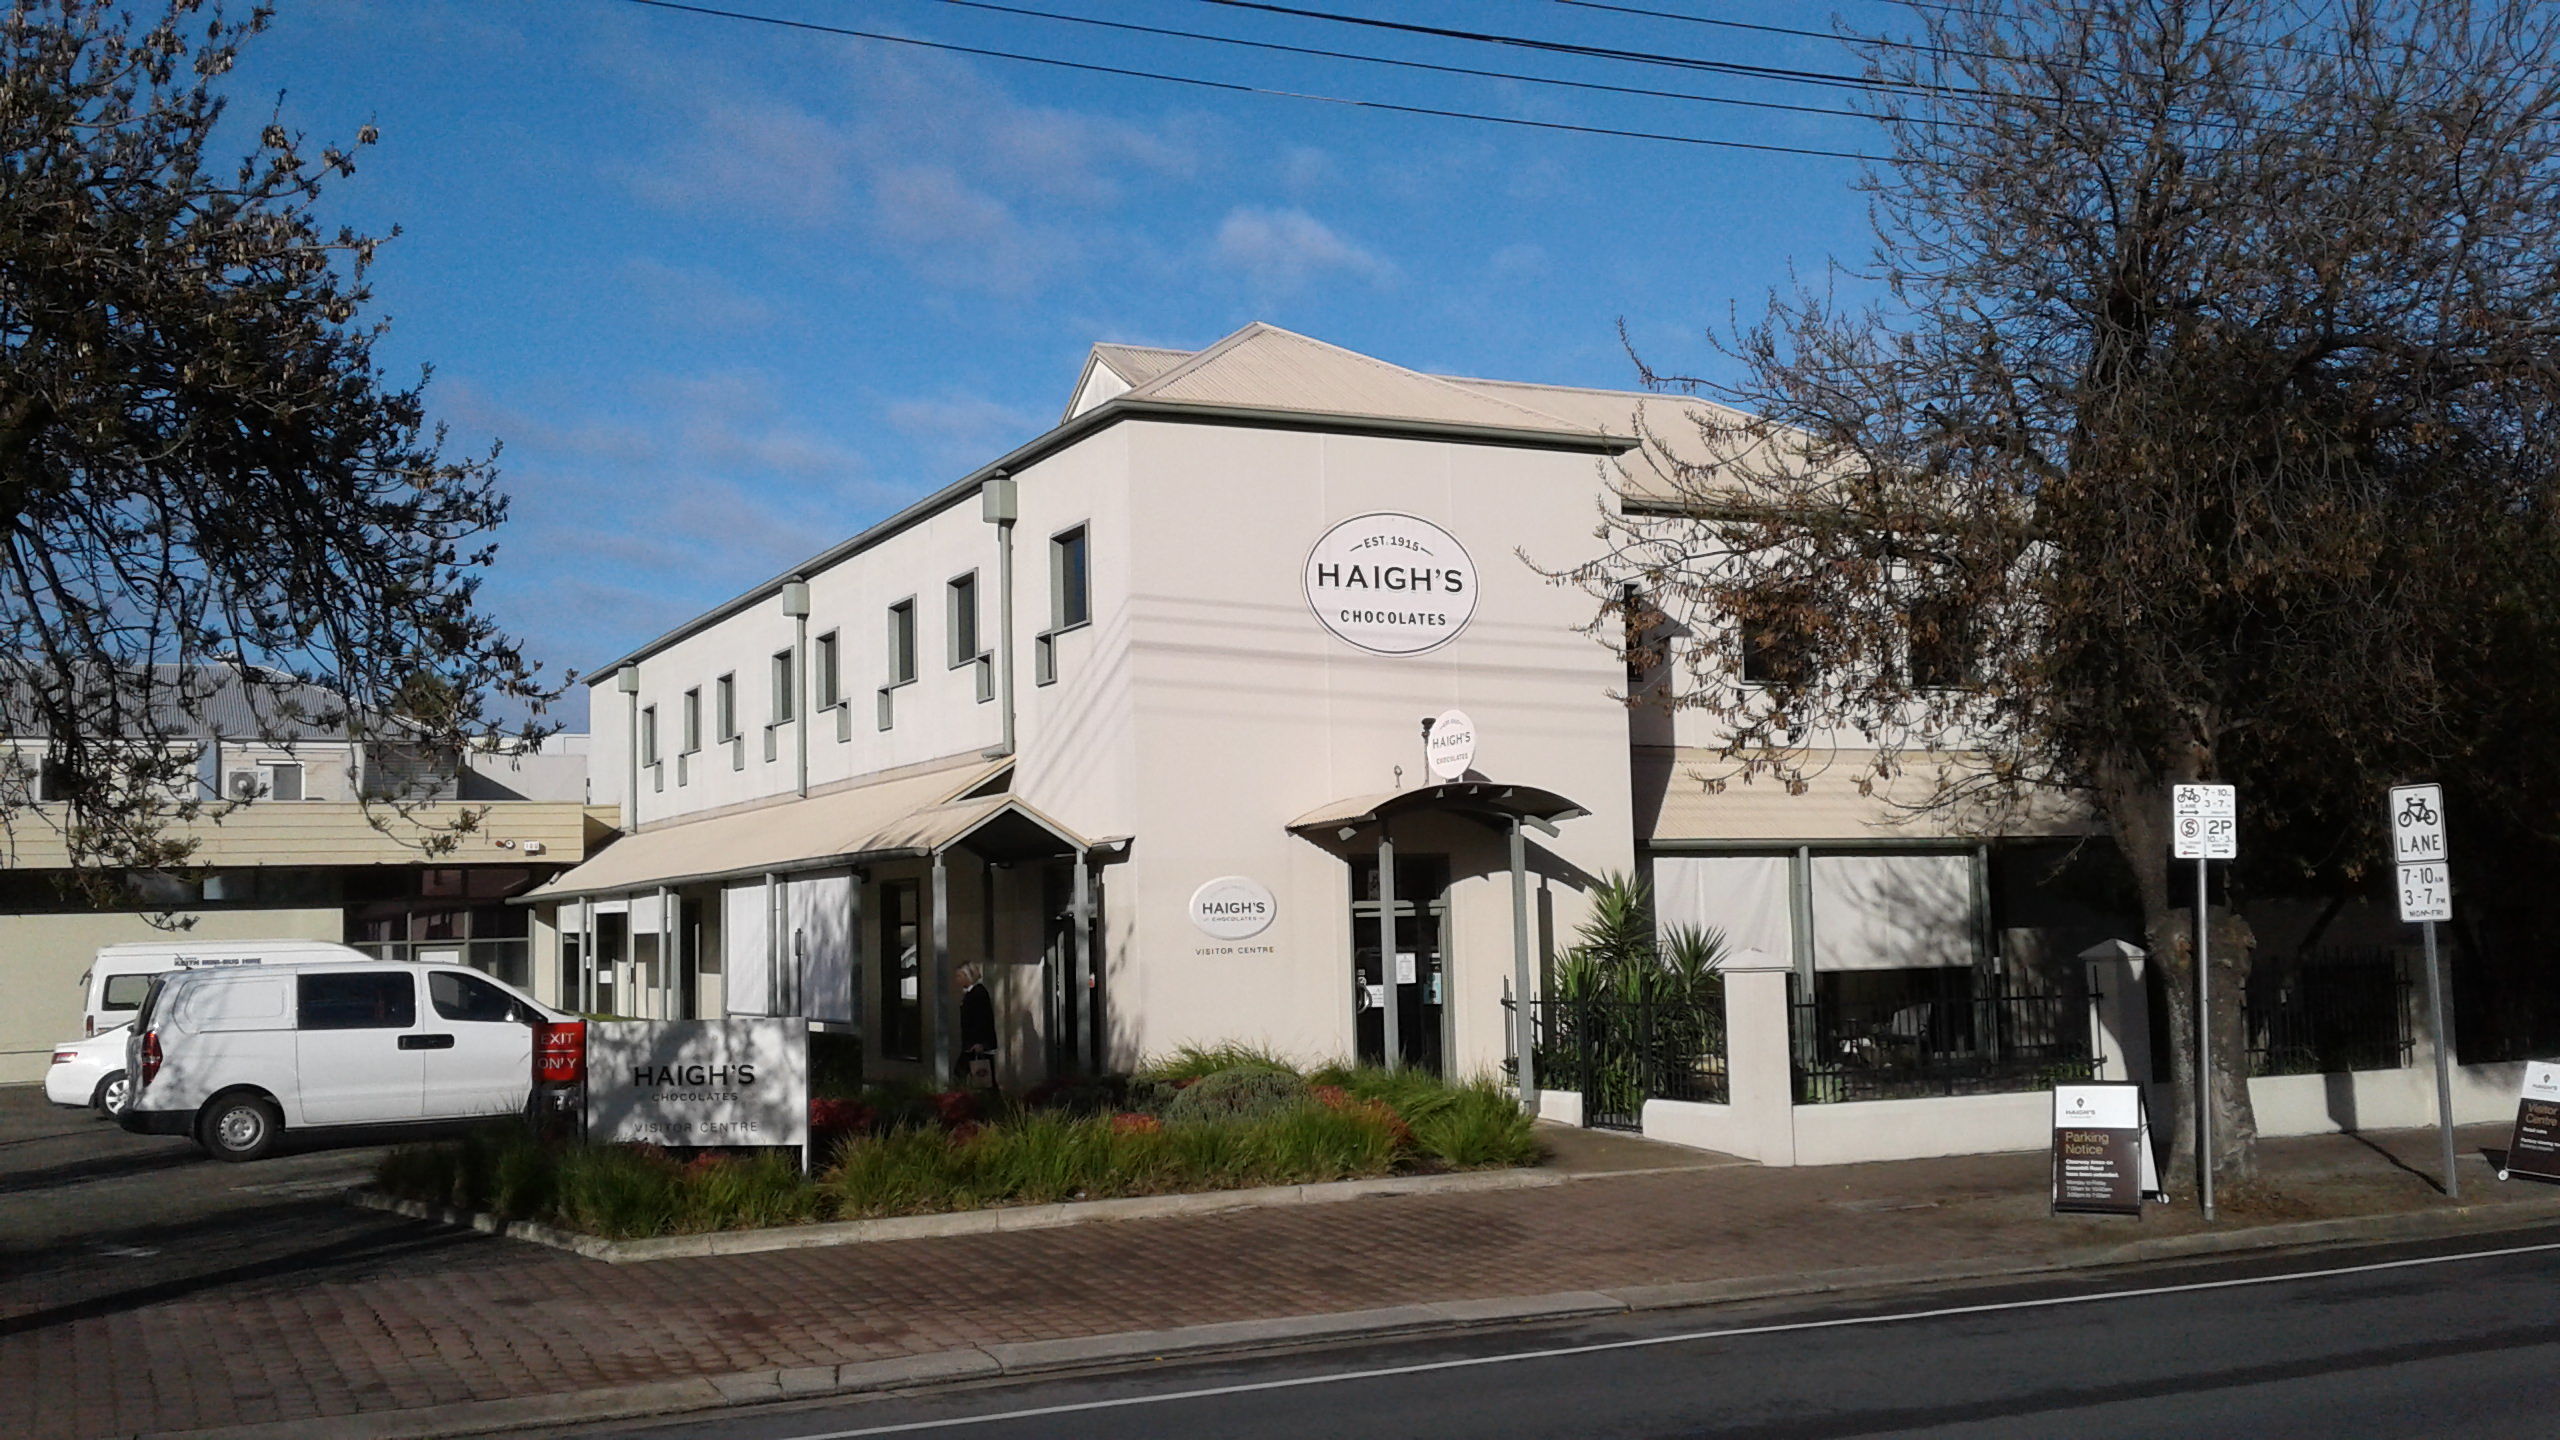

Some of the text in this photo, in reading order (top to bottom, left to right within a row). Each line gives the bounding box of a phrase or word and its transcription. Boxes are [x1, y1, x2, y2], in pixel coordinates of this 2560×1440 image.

[1390, 535, 1420, 552] 1915
[1317, 562, 1463, 593] HAIGH'S
[1340, 609, 1446, 626] CHOCOLATES
[1432, 731, 1471, 749] HAIGH'S
[2208, 820, 2232, 835] 2P
[2399, 834, 2441, 853] LANE
[1202, 901, 1266, 914] HAIGH'S
[1195, 946, 1275, 956] VISITOR CENTRE
[540, 1032, 576, 1045] EXIT
[634, 1065, 756, 1087] HAIGH'S
[651, 1092, 738, 1102] CHOCOLATES
[634, 1120, 758, 1134] VISITOR CENTRE
[2065, 1131, 2109, 1145] Parking
[2065, 1144, 2104, 1155] Notice
